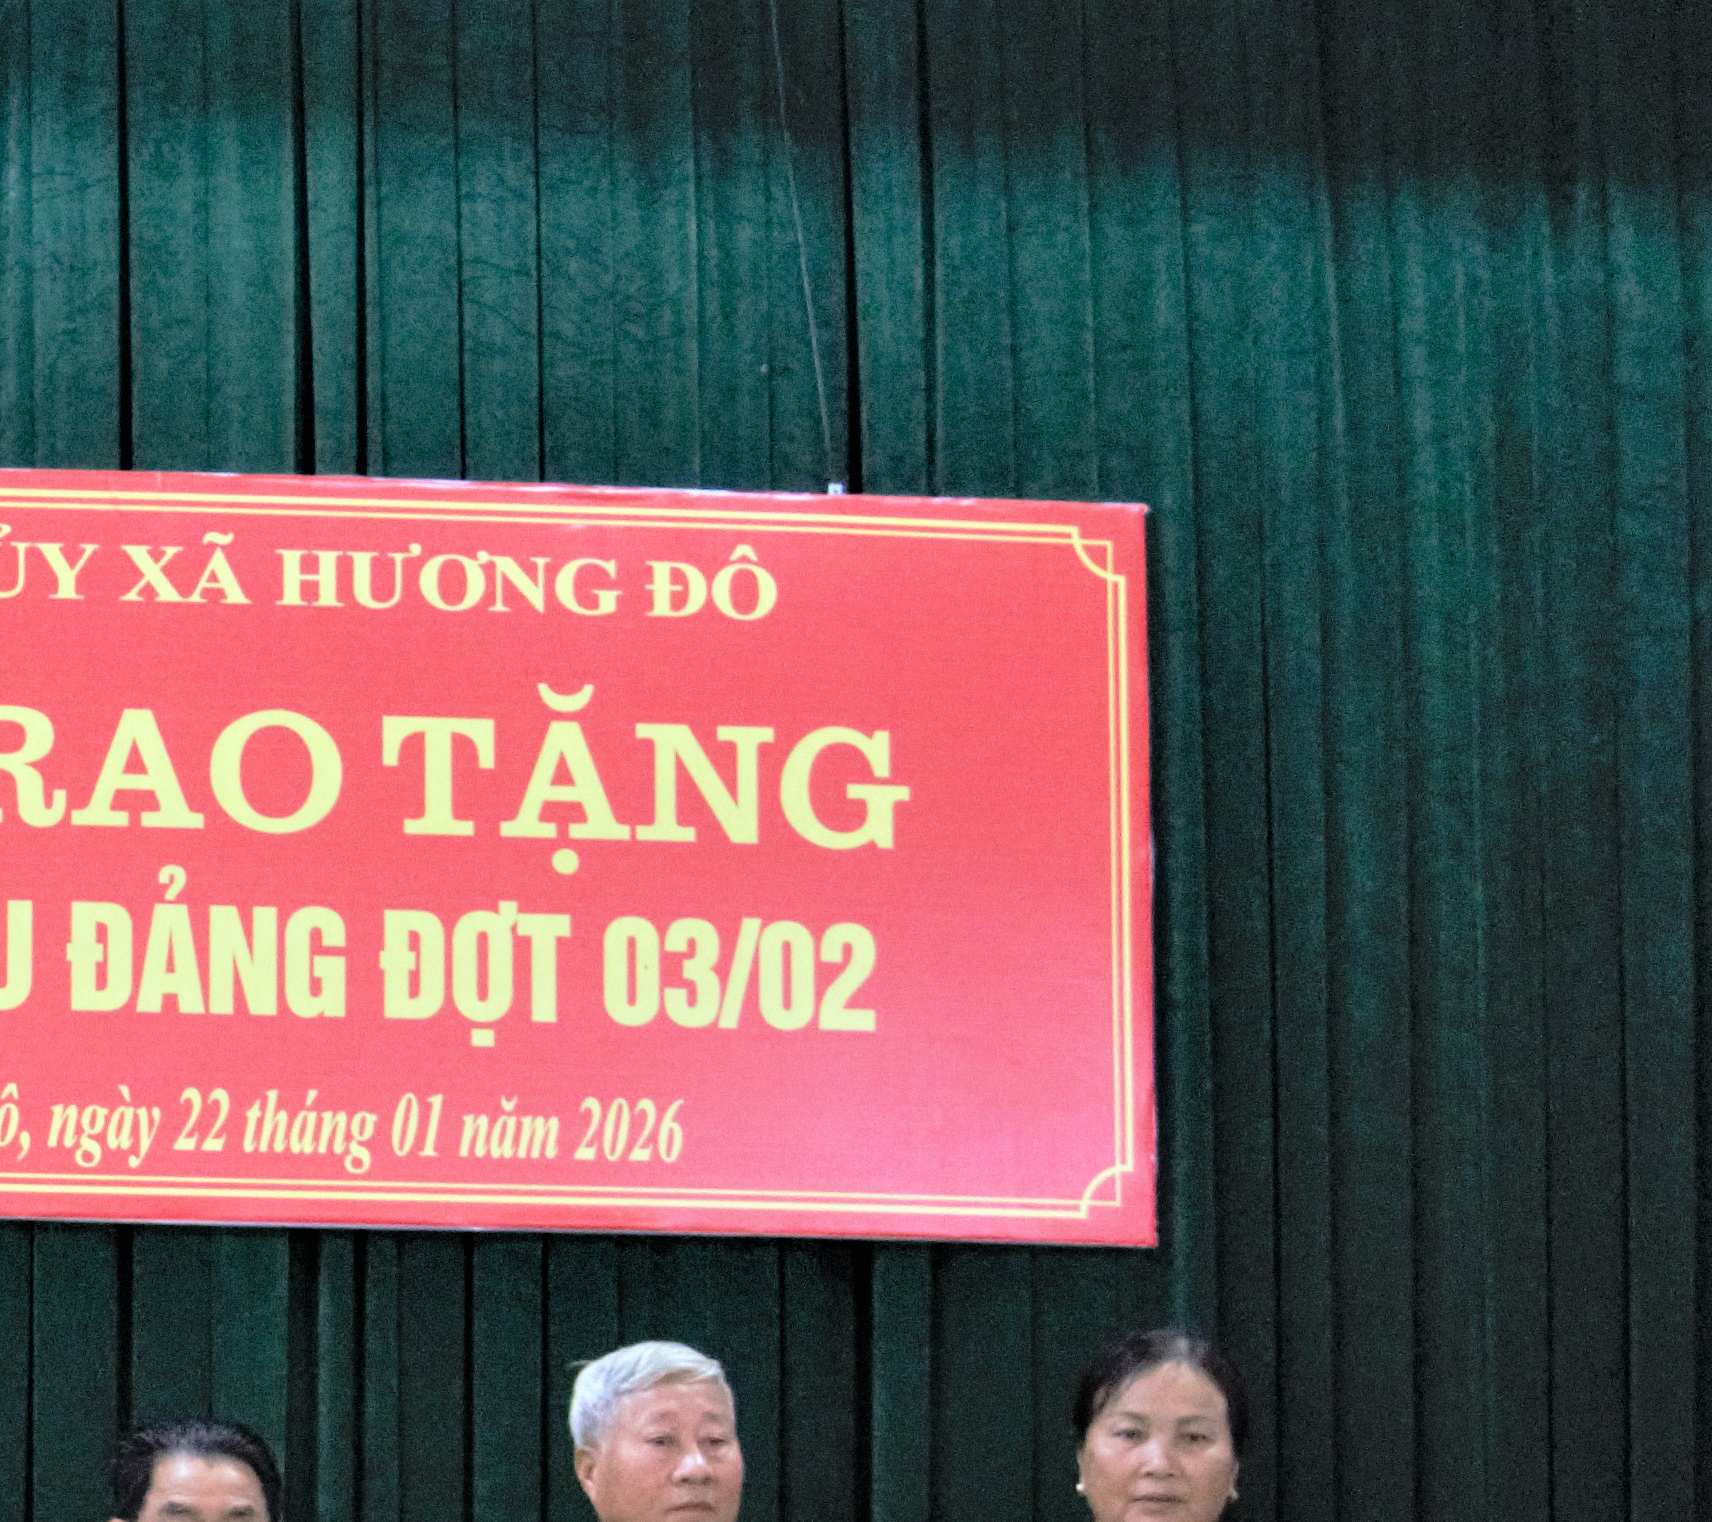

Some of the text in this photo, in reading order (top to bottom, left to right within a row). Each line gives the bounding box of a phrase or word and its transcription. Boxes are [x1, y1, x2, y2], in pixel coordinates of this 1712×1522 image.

[120, 532, 251, 604] XÃ
[275, 543, 622, 616] HƯƠNG
[645, 544, 777, 620] ĐÔ
[382, 683, 910, 875] TẶNG
[66, 864, 346, 1018] ĐẢNG
[379, 901, 571, 1047] ĐỢT
[603, 916, 877, 1032] 03/02
[47, 1090, 161, 1168] ngày
[173, 1087, 230, 1151] 22
[243, 1089, 377, 1174] tháng
[392, 1093, 443, 1157] 01
[459, 1096, 559, 1159] năm
[574, 1097, 684, 1163] 2026
